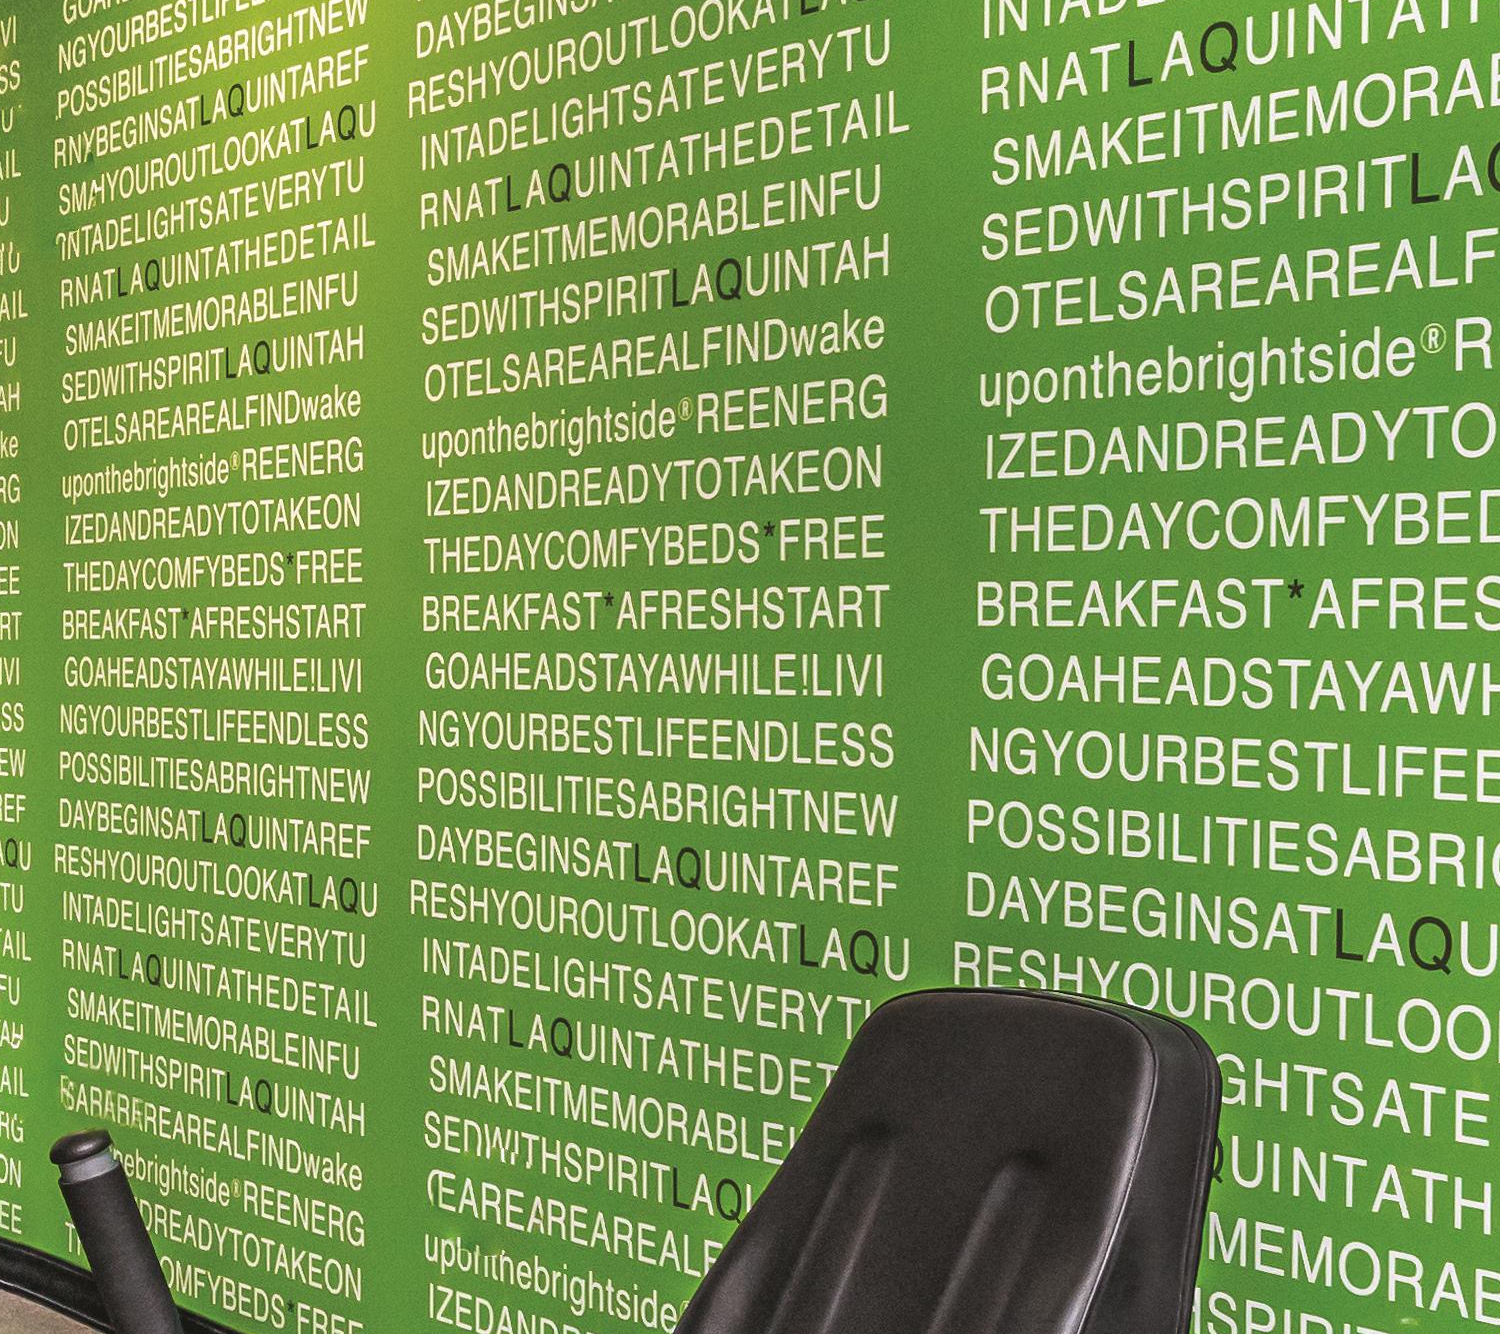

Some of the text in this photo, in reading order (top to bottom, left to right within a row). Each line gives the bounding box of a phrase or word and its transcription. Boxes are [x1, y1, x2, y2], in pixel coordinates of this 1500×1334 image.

[422, 19, 889, 170] INTADELIGHTSATEVERYTU
[421, 91, 909, 230] RNATLAQUINTATHEDETAIL
[62, 213, 375, 309] RNATLAQUINTATHEDETAIL
[428, 164, 880, 286] SMAKEITMEMORABLEINFU
[66, 271, 357, 355] SMAKEITMEMORABLEINFU
[422, 233, 888, 344] SEDWITHSPIRITLAQUINTAH
[62, 325, 363, 403] SEDWITHSPIRITLAQUINTAH
[425, 309, 884, 401] OTELSAREAREALFINDwake
[64, 385, 360, 450] OTELSAREAREALFINDwake
[66, 493, 360, 544] IZEDANDREADYTOTAKEON
[428, 445, 881, 516] IZEDANDREADYTOTAKEON
[65, 657, 361, 692] GOAHEADSTAYAWHILE!LIVI
[426, 652, 882, 697] GOAHEADSTAYAWHILE!LIVI
[61, 704, 368, 749] NGYOURBESTLIFEENDLESS
[420, 710, 893, 768] NGYOURBESTLIFEENDLESS
[60, 751, 370, 804] POSSIBILITIESABRIGHTNEW
[419, 768, 898, 837] POSSIBILITIESABRIGHTNEW
[60, 798, 370, 859] DAYBEGINSATLAQUINTAREF
[418, 825, 898, 906] DAYBEGINSATLAQUINTAREF
[55, 844, 377, 917] RESHYOUROUTLOOKATLAQU
[64, 891, 365, 968] INTADELIGHTSATEVERYTU
[411, 880, 909, 981] RESHYOUROUTLOOKATLAQU
[63, 939, 377, 1027] RNATLAQUINTATHEDETAIL
[68, 987, 359, 1079] SMAKEITMEMORABLEINFU
[430, 1055, 803, 1165] SMAKEITMEMORABLEI
[425, 1111, 753, 1224] SEDWITHSPIRITLAQ
